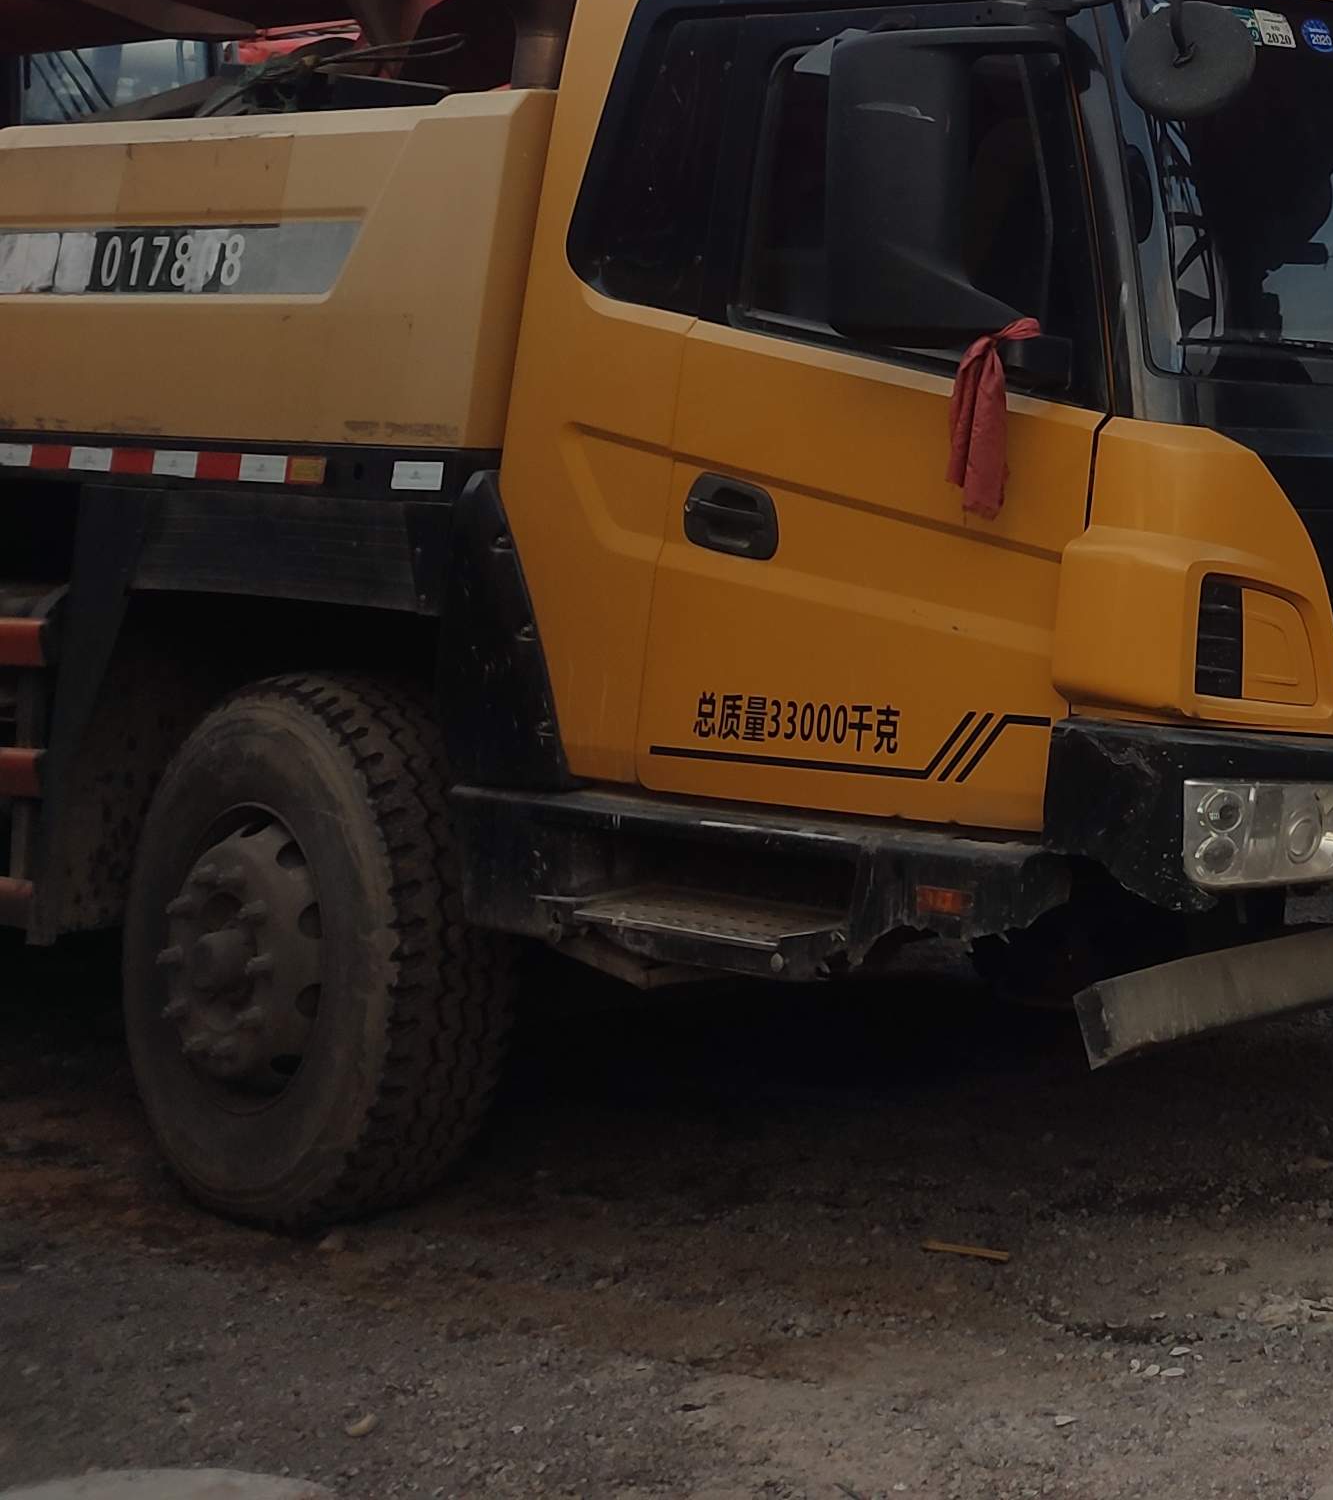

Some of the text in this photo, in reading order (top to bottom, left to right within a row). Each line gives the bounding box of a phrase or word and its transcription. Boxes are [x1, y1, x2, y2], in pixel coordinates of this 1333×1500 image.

[1265, 32, 1292, 45] 2020
[101, 234, 246, 287] 01788
[692, 691, 901, 754] 总质量33000千克
